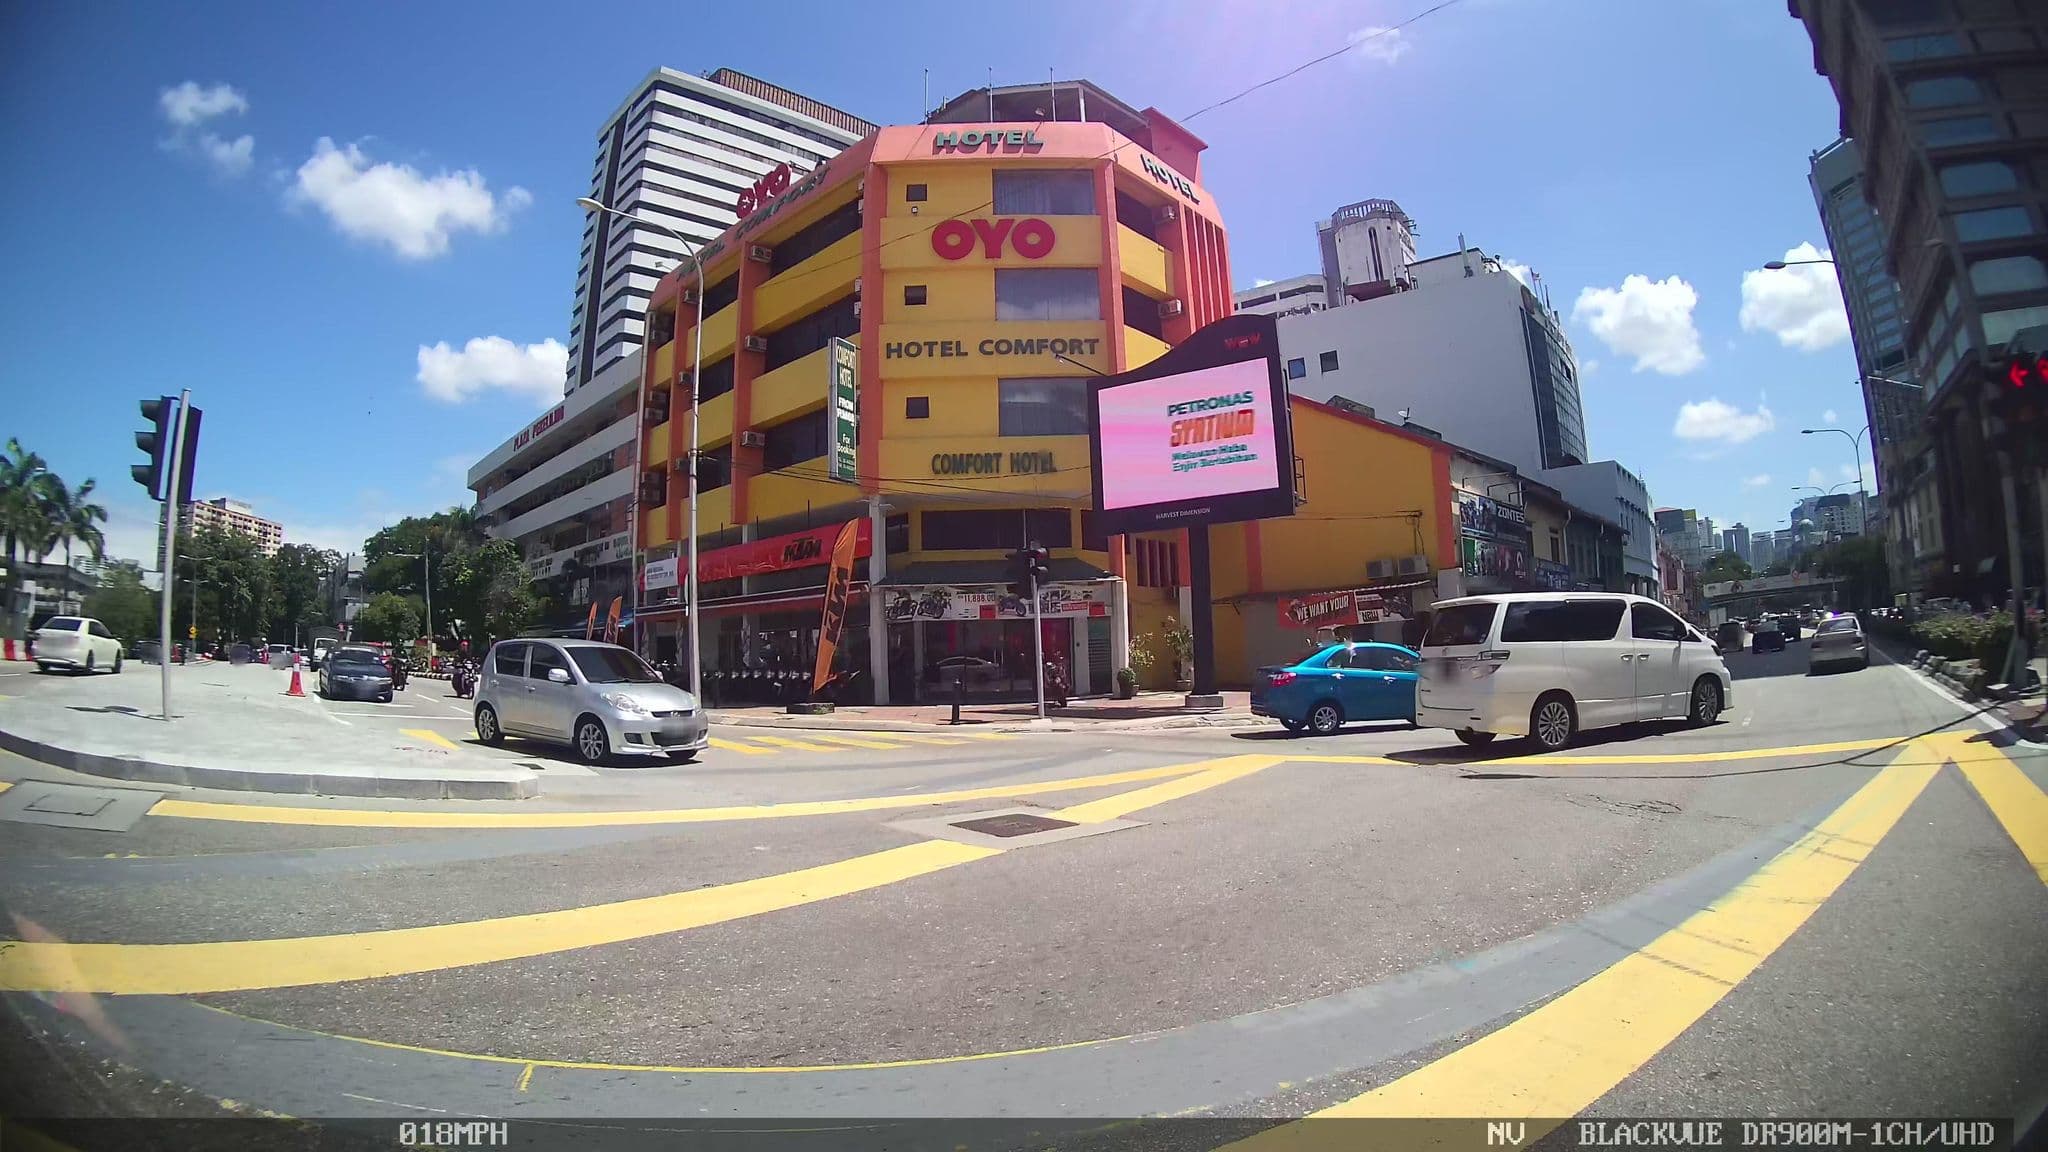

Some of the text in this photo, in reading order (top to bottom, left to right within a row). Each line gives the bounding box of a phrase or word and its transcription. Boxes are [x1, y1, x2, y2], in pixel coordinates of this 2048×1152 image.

[936, 130, 1045, 148] HOTEL
[736, 163, 791, 218] OYO
[1140, 153, 1200, 205] HOTEL
[931, 218, 1056, 261] OYO
[886, 338, 1100, 359] HOTEL COMFORT
[1167, 391, 1254, 416] PETRONAS
[513, 429, 529, 452] PLAZA
[931, 452, 1058, 475] COMFORT HOTEL
[1496, 505, 1526, 523] ZONTES
[784, 537, 822, 562] KTM
[1296, 605, 1309, 621] WE
[1309, 600, 1329, 617] WANT
[1330, 595, 1349, 611] YOUR
